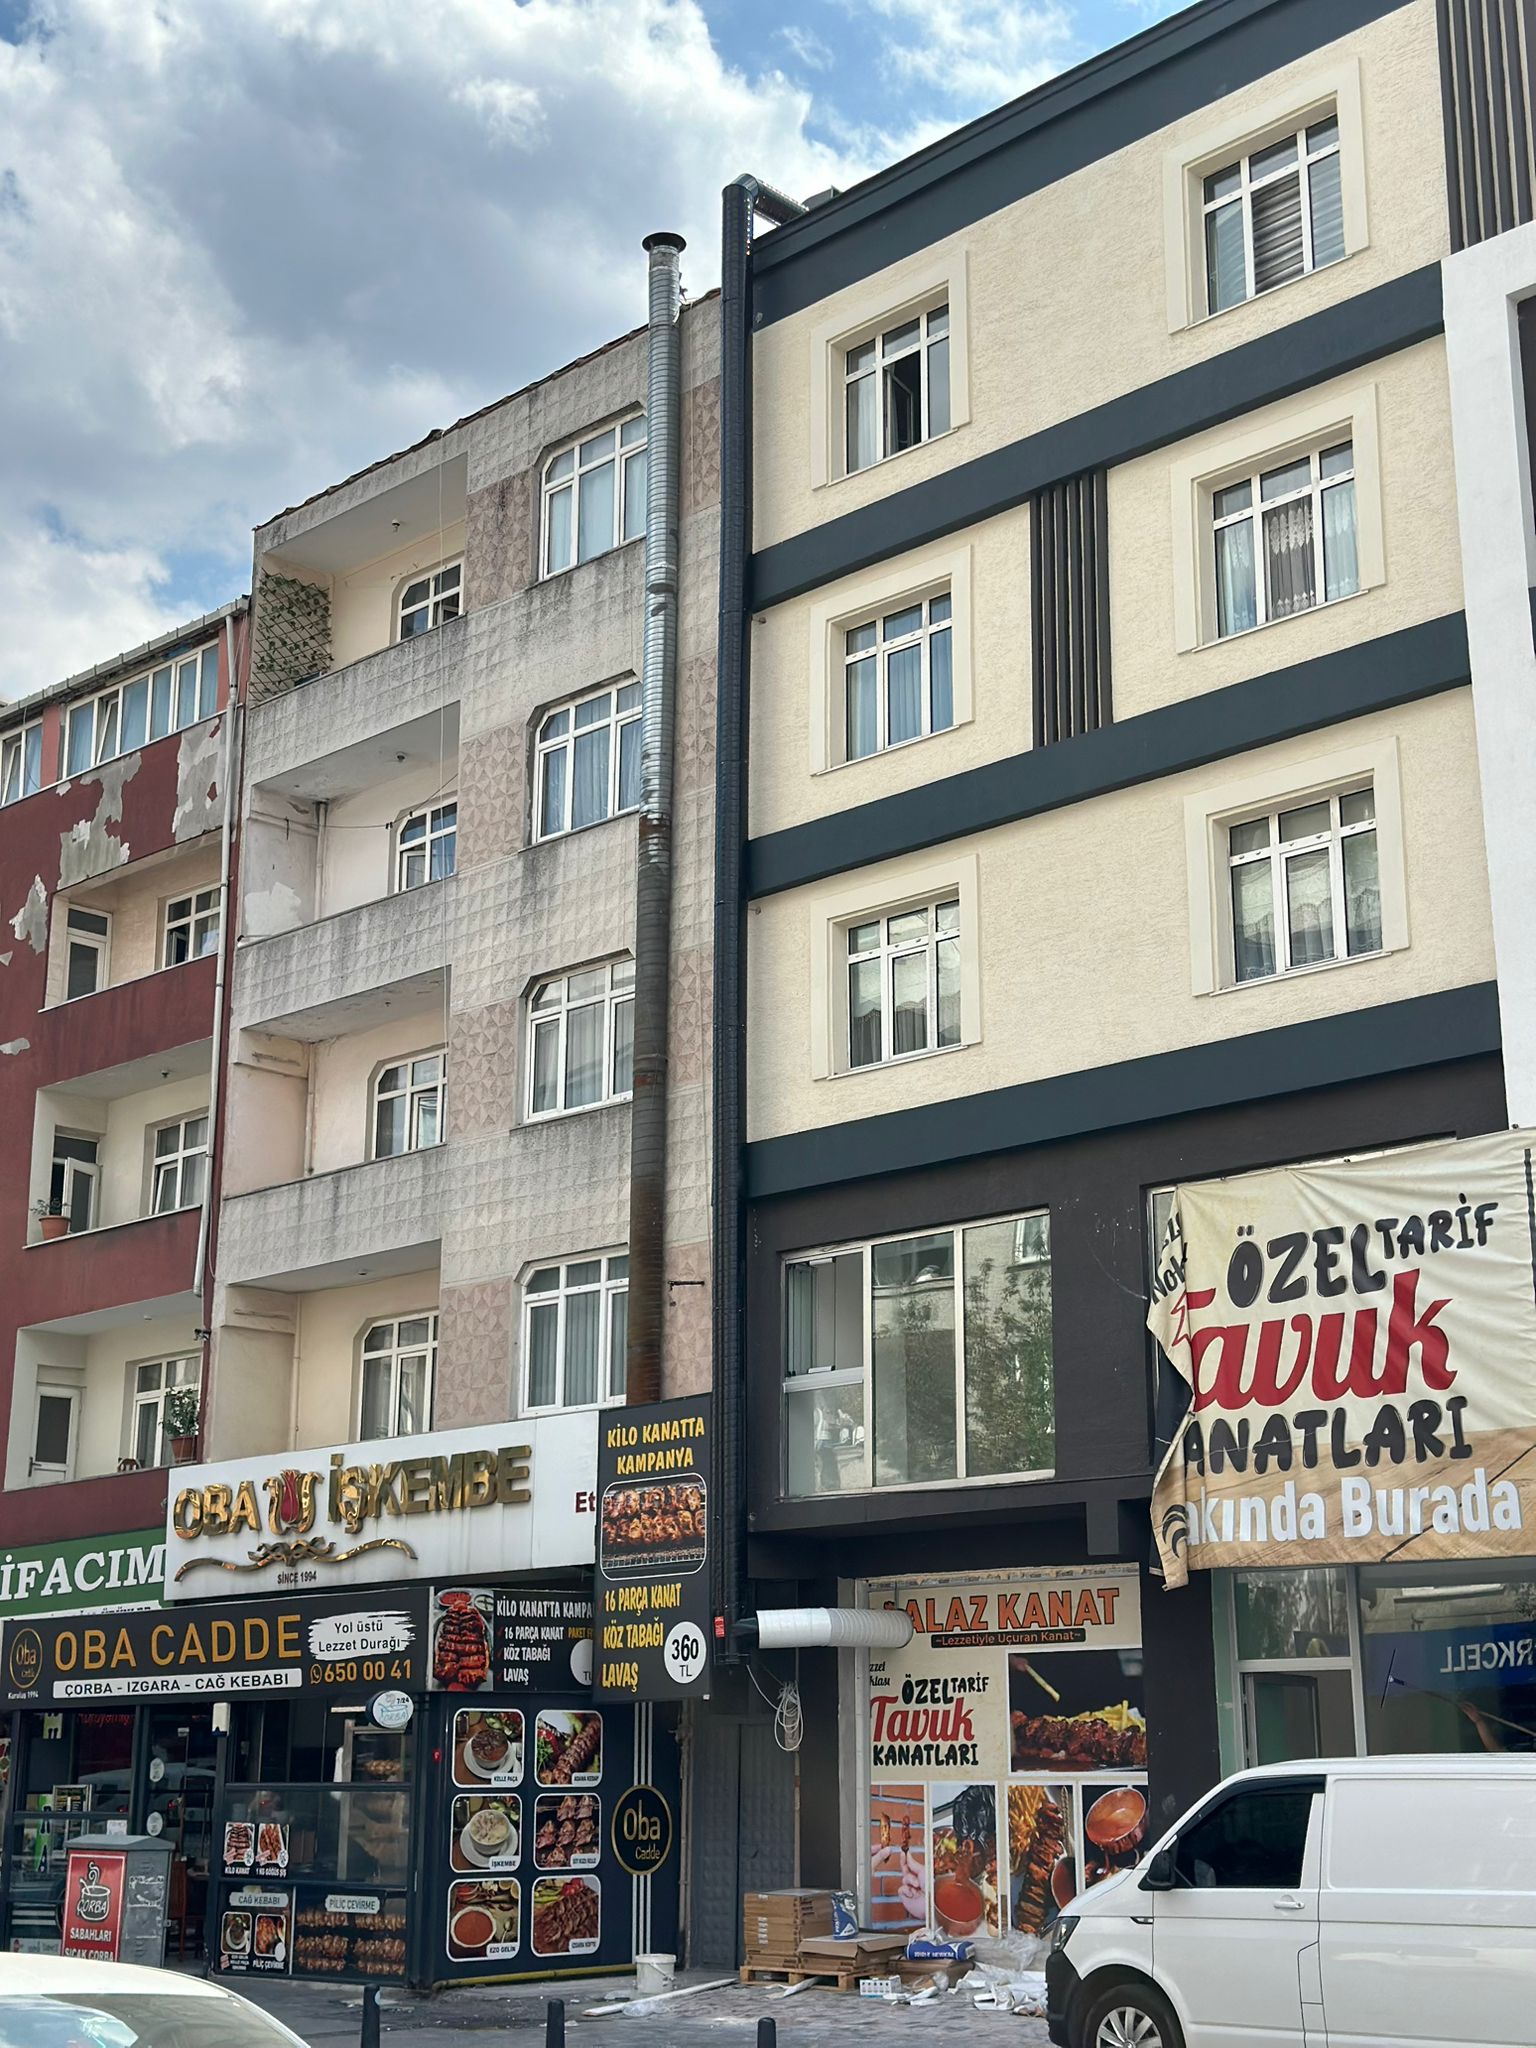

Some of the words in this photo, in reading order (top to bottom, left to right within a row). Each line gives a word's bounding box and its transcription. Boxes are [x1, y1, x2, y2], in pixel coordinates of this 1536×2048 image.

[1227, 1225, 1386, 1308] ÖZEL
[1377, 1193, 1499, 1260] TARİF
[607, 1424, 638, 1448] KİLO
[642, 1417, 705, 1443] KANATTA
[617, 1447, 693, 1474] KAMPANYA
[173, 1480, 262, 1539] OBA
[328, 1445, 532, 1534] İŞKEMBE
[576, 1491, 595, 1513] Et
[1341, 1468, 1522, 1538] Burada
[300, 1570, 317, 1582] 1994
[496, 1596, 516, 1617] KİLO
[519, 1600, 560, 1618] KANAT'TA
[605, 1590, 616, 1611] 16
[618, 1586, 648, 1616] PARÇA
[651, 1583, 682, 1609] KANAT
[998, 1588, 1119, 1630] KANAT
[335, 1621, 353, 1633] Yol
[357, 1620, 383, 1632] üstü
[505, 1627, 513, 1640] 16
[515, 1627, 539, 1643] PARÇA
[541, 1627, 564, 1641] KANAT
[603, 1619, 624, 1649] KÖZ
[626, 1616, 663, 1648] TABAĞI
[998, 1632, 1038, 1644] Uçuran
[16, 1639, 37, 1665] Oba
[55, 1628, 137, 1671] OBA
[152, 1614, 301, 1666] CADDE
[318, 1640, 356, 1652] Lezzet
[361, 1636, 400, 1650] Durağı
[504, 1646, 520, 1661] KÖZ
[522, 1646, 550, 1661] TABAĞI
[671, 1634, 699, 1661] 360
[324, 1662, 357, 1682] 650
[363, 1661, 385, 1680] 00
[390, 1659, 411, 1679] 41
[503, 1668, 529, 1685] LAVAŞ
[602, 1662, 638, 1692] LAVAŞ
[680, 1665, 692, 1677] TL
[65, 1680, 113, 1697] ÇORBA
[127, 1679, 180, 1693] IZGARA
[195, 1674, 226, 1690] CAĞ
[230, 1673, 289, 1687] KEBABI
[902, 1673, 954, 1704] ÖZEL
[951, 1672, 989, 1693] TARİF
[870, 1696, 975, 1742] Tavuk
[873, 1744, 979, 1766] KANATLARI
[624, 1799, 660, 1840] Oba
[635, 1842, 661, 1859] Cadde
[70, 1926, 112, 1942] SABAHLARI
